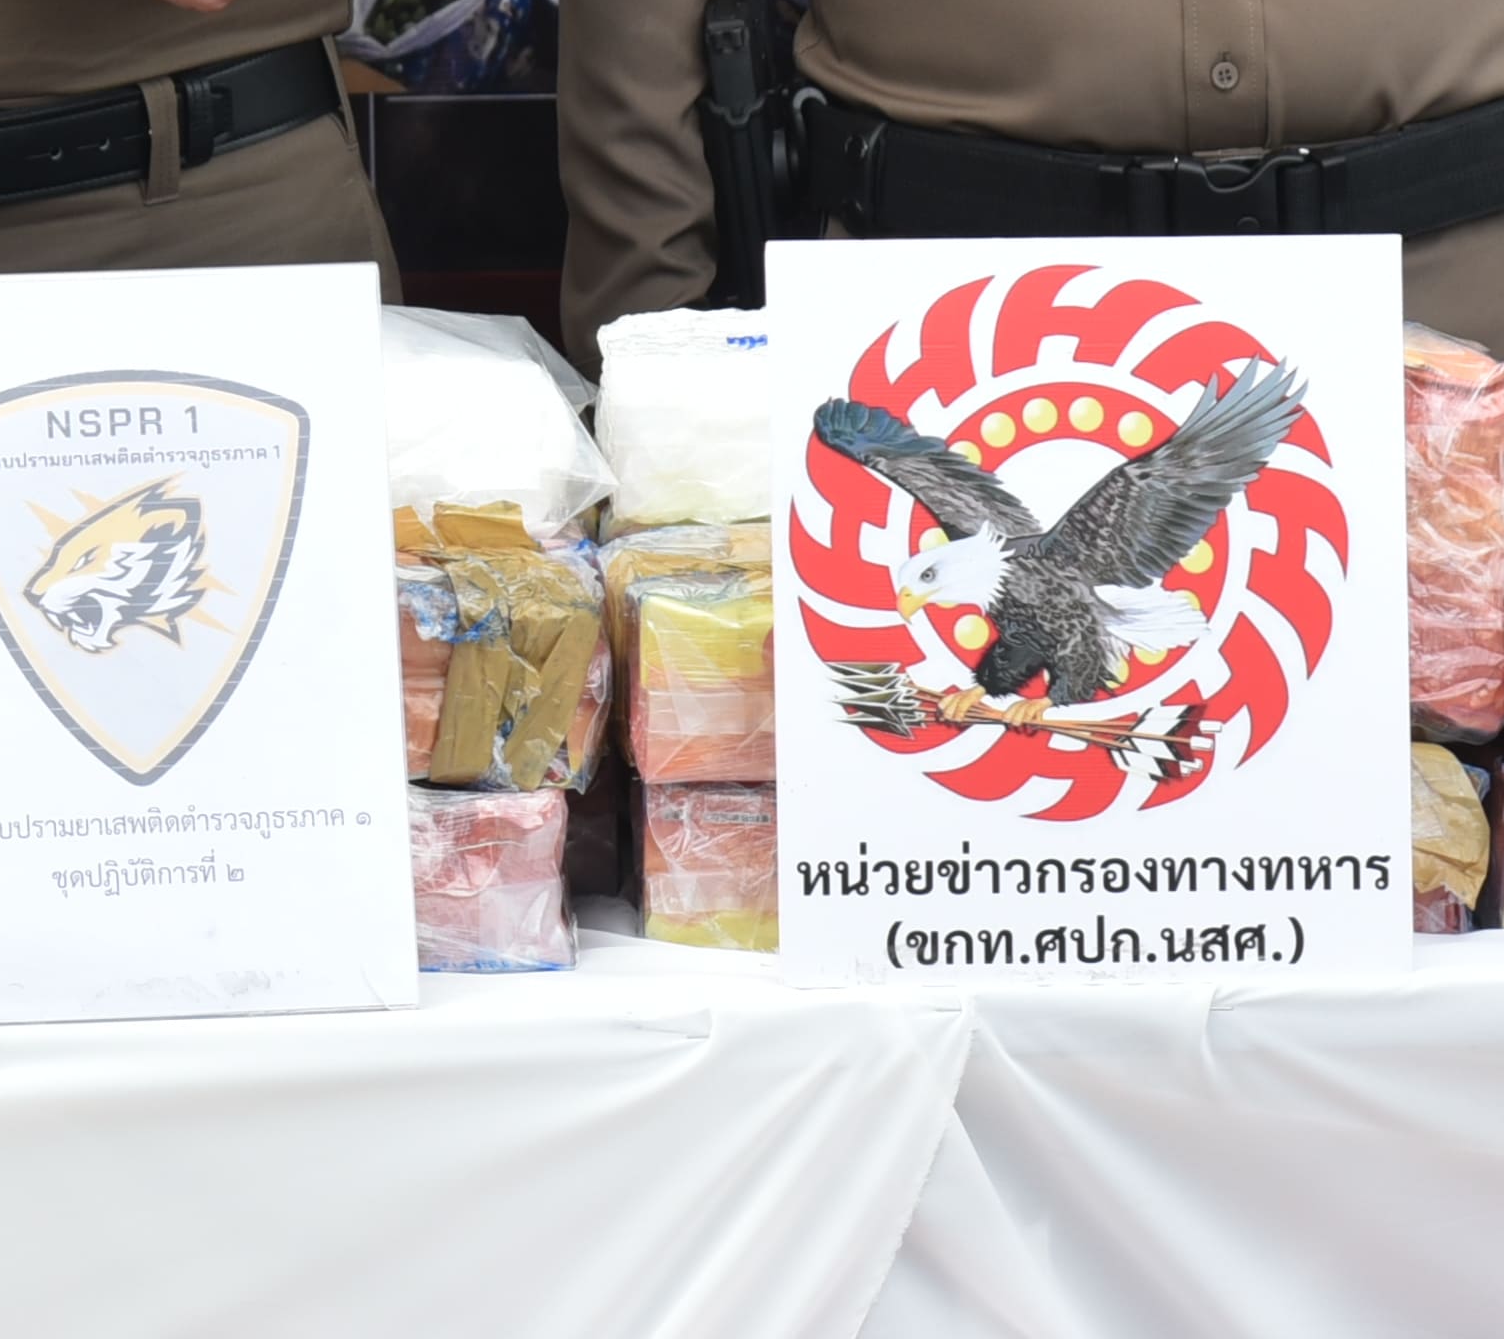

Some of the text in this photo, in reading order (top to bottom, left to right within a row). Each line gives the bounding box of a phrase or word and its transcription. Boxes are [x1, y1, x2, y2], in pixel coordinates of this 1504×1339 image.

[45, 405, 202, 439] NSPR 1
[272, 444, 282, 461] 1
[51, 849, 217, 898] ชุดปฏิบัติการที่
[796, 840, 1392, 898] หน่วยข่าวกรองทางทหาร
[885, 915, 1308, 970] (ขกท.ศปก.นสศ.)
